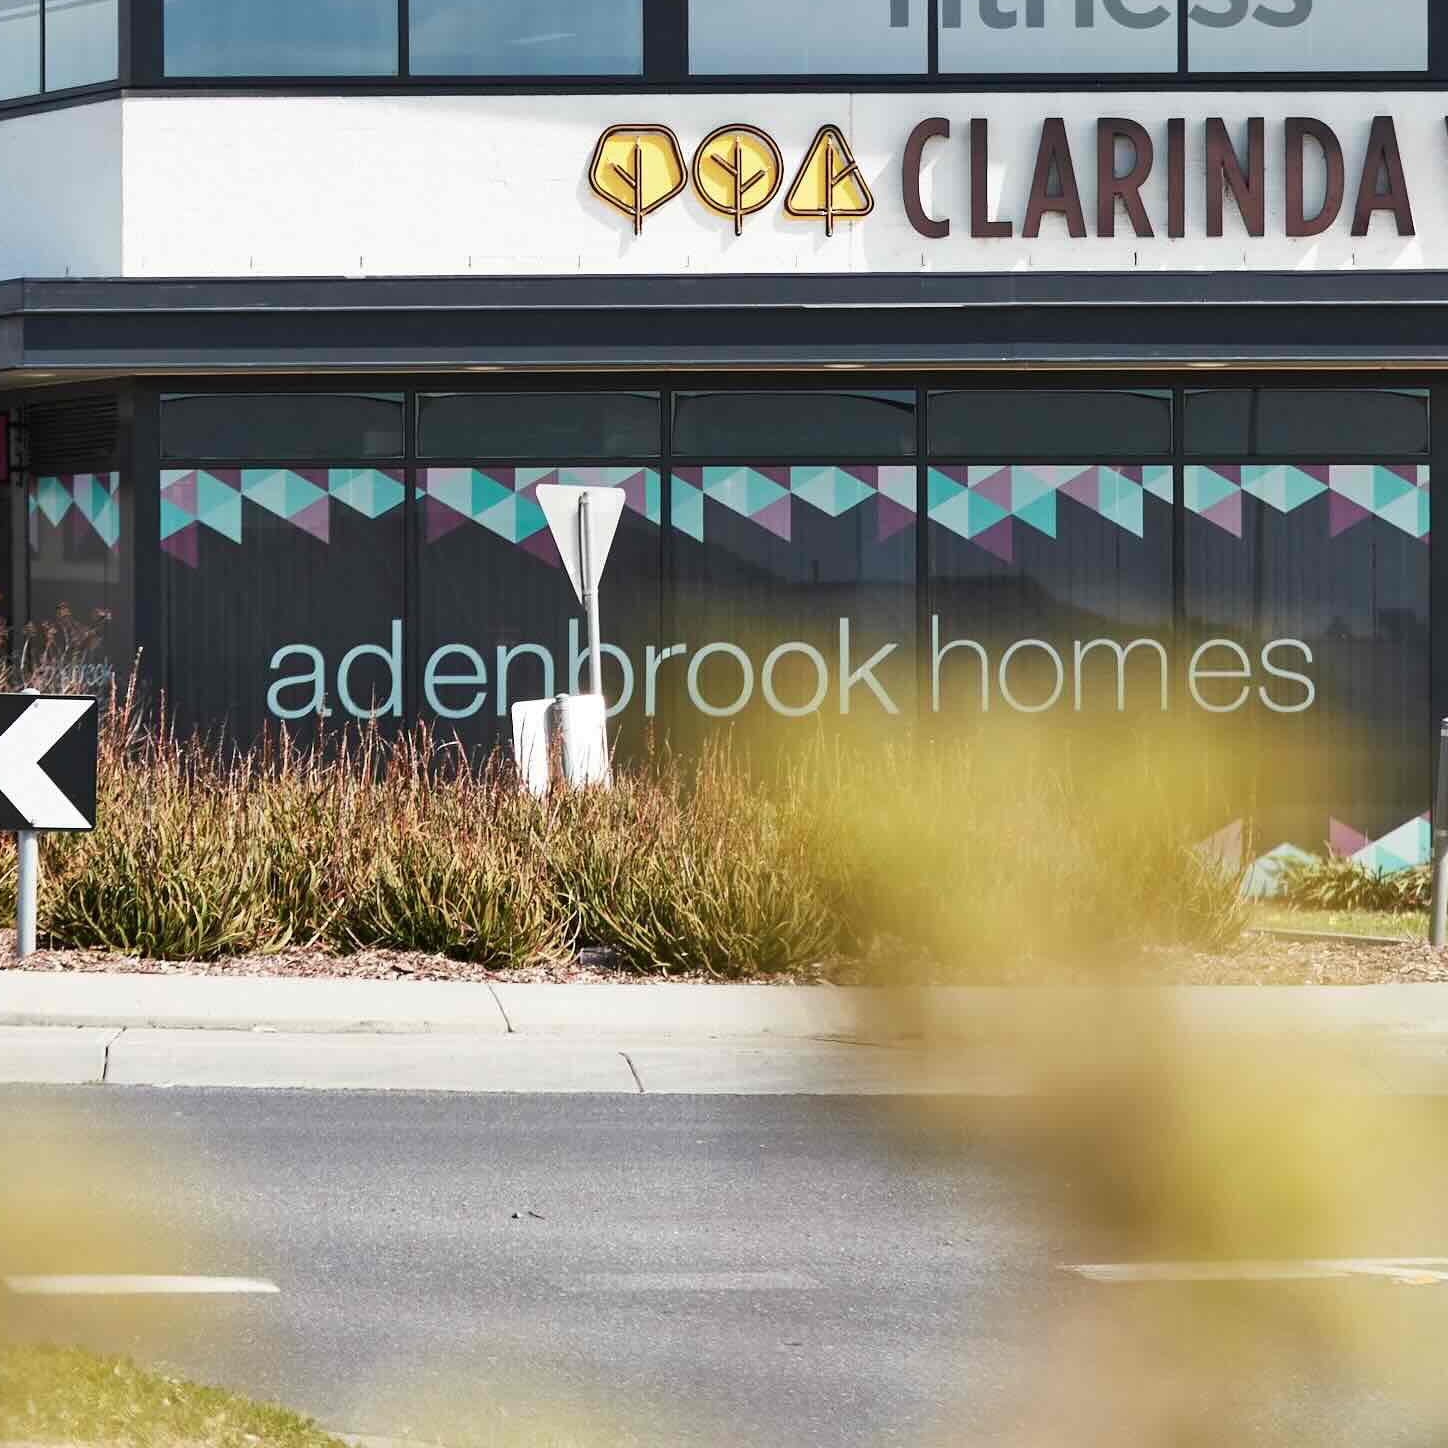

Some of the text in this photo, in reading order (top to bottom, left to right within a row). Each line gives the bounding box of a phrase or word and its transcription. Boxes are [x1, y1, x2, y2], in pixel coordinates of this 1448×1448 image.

[901, 114, 1416, 239] CLARINDA
[266, 613, 1317, 720] adenbrook homes
